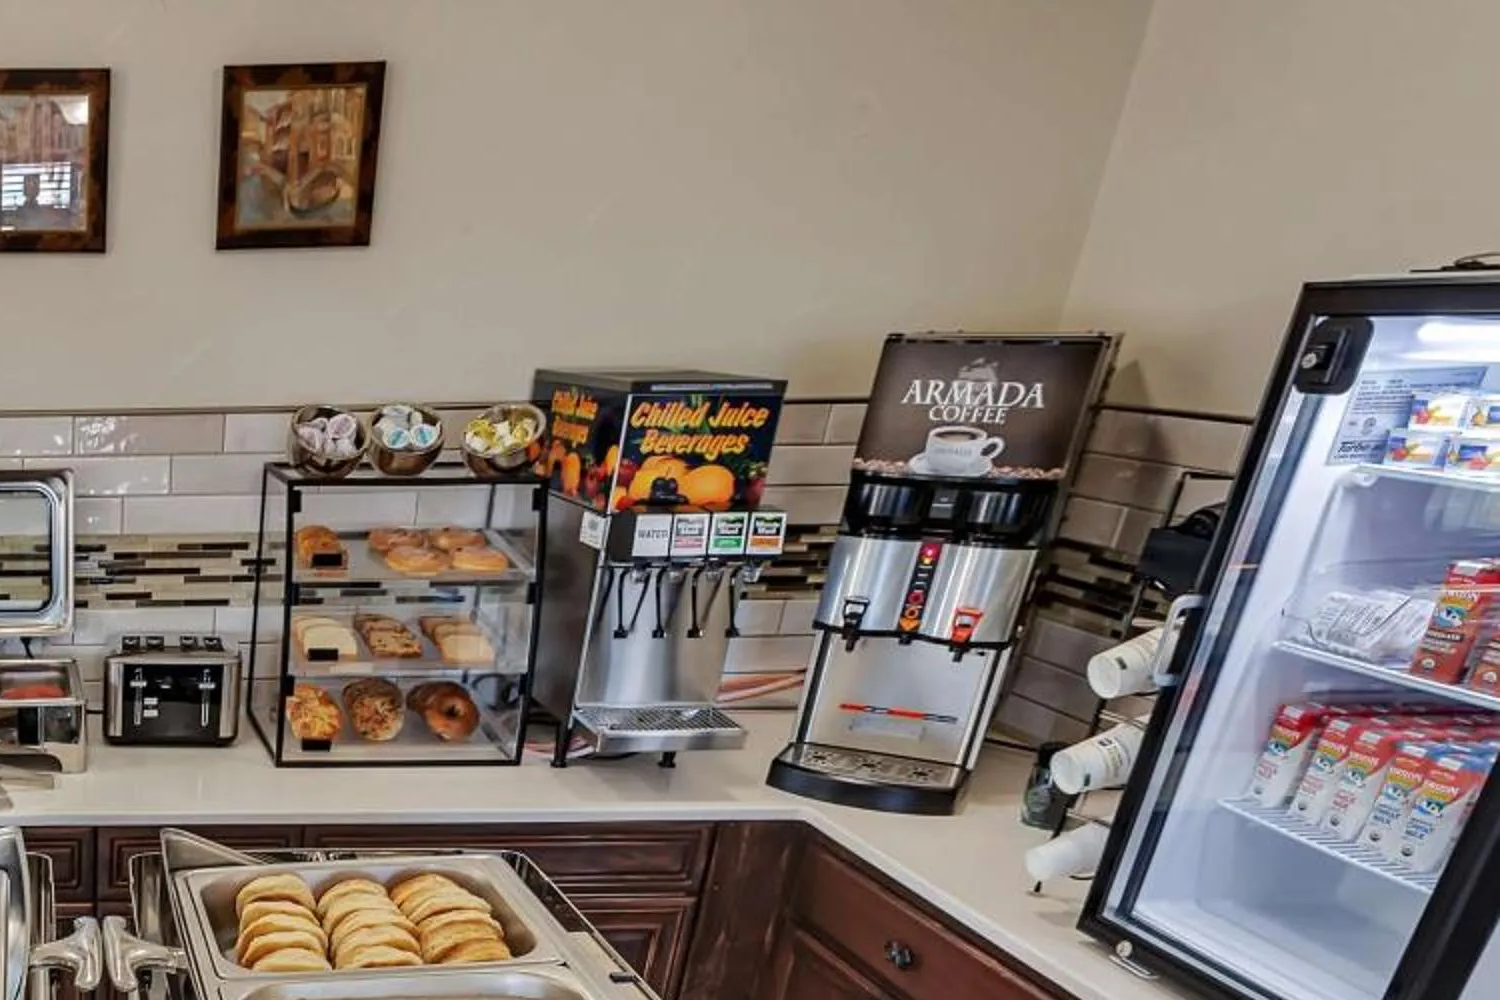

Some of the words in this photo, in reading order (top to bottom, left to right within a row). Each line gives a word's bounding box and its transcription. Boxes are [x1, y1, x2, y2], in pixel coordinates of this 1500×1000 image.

[901, 379, 1045, 408] ARMADA
[630, 400, 710, 429] Chilled
[709, 402, 771, 428] Juice
[928, 405, 1007, 424] COFFEE
[639, 429, 750, 460] Beverages
[637, 529, 669, 539] WATER
